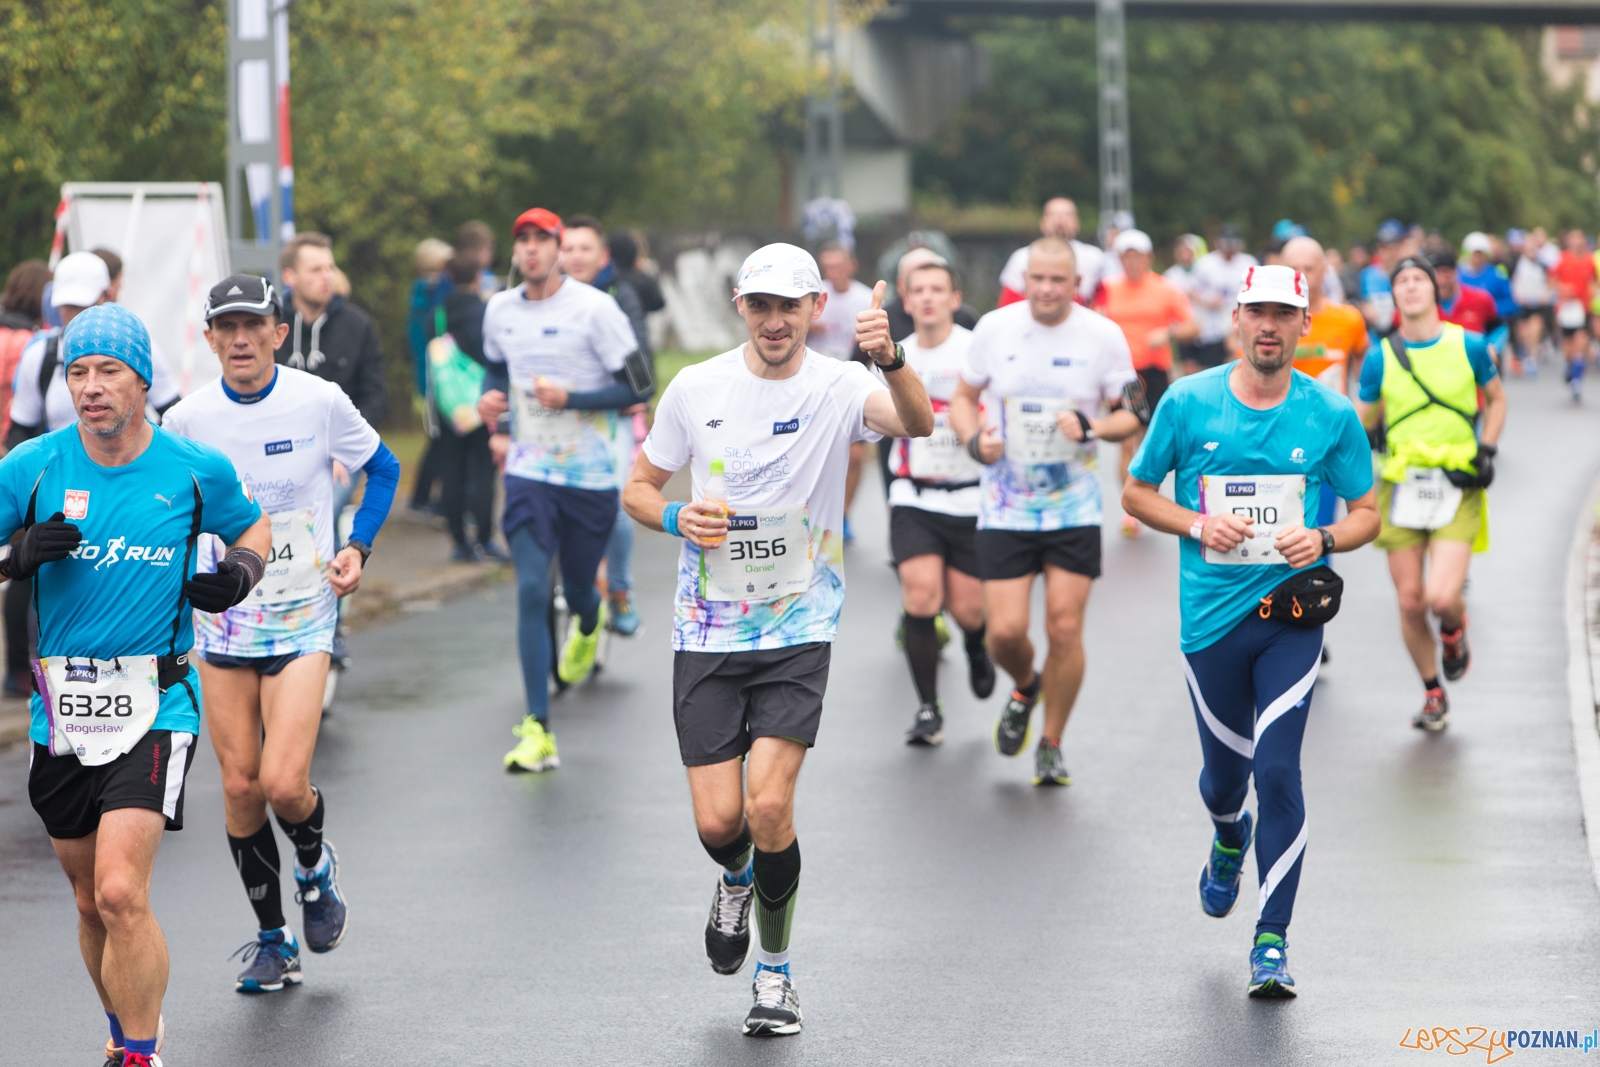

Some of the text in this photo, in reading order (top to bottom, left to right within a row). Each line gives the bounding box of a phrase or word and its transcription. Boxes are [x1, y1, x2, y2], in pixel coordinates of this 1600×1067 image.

[706, 419, 723, 428] 4F
[1203, 441, 1219, 451] 4F
[724, 447, 752, 458] SIŁA
[1228, 485, 1254, 494] 17.PKO
[1232, 507, 1277, 524] 5110
[124, 546, 175, 561] RUN
[730, 538, 786, 560] 3156
[745, 563, 775, 573] Daniel
[59, 694, 132, 717] 6328
[66, 723, 124, 735] Bogusław
